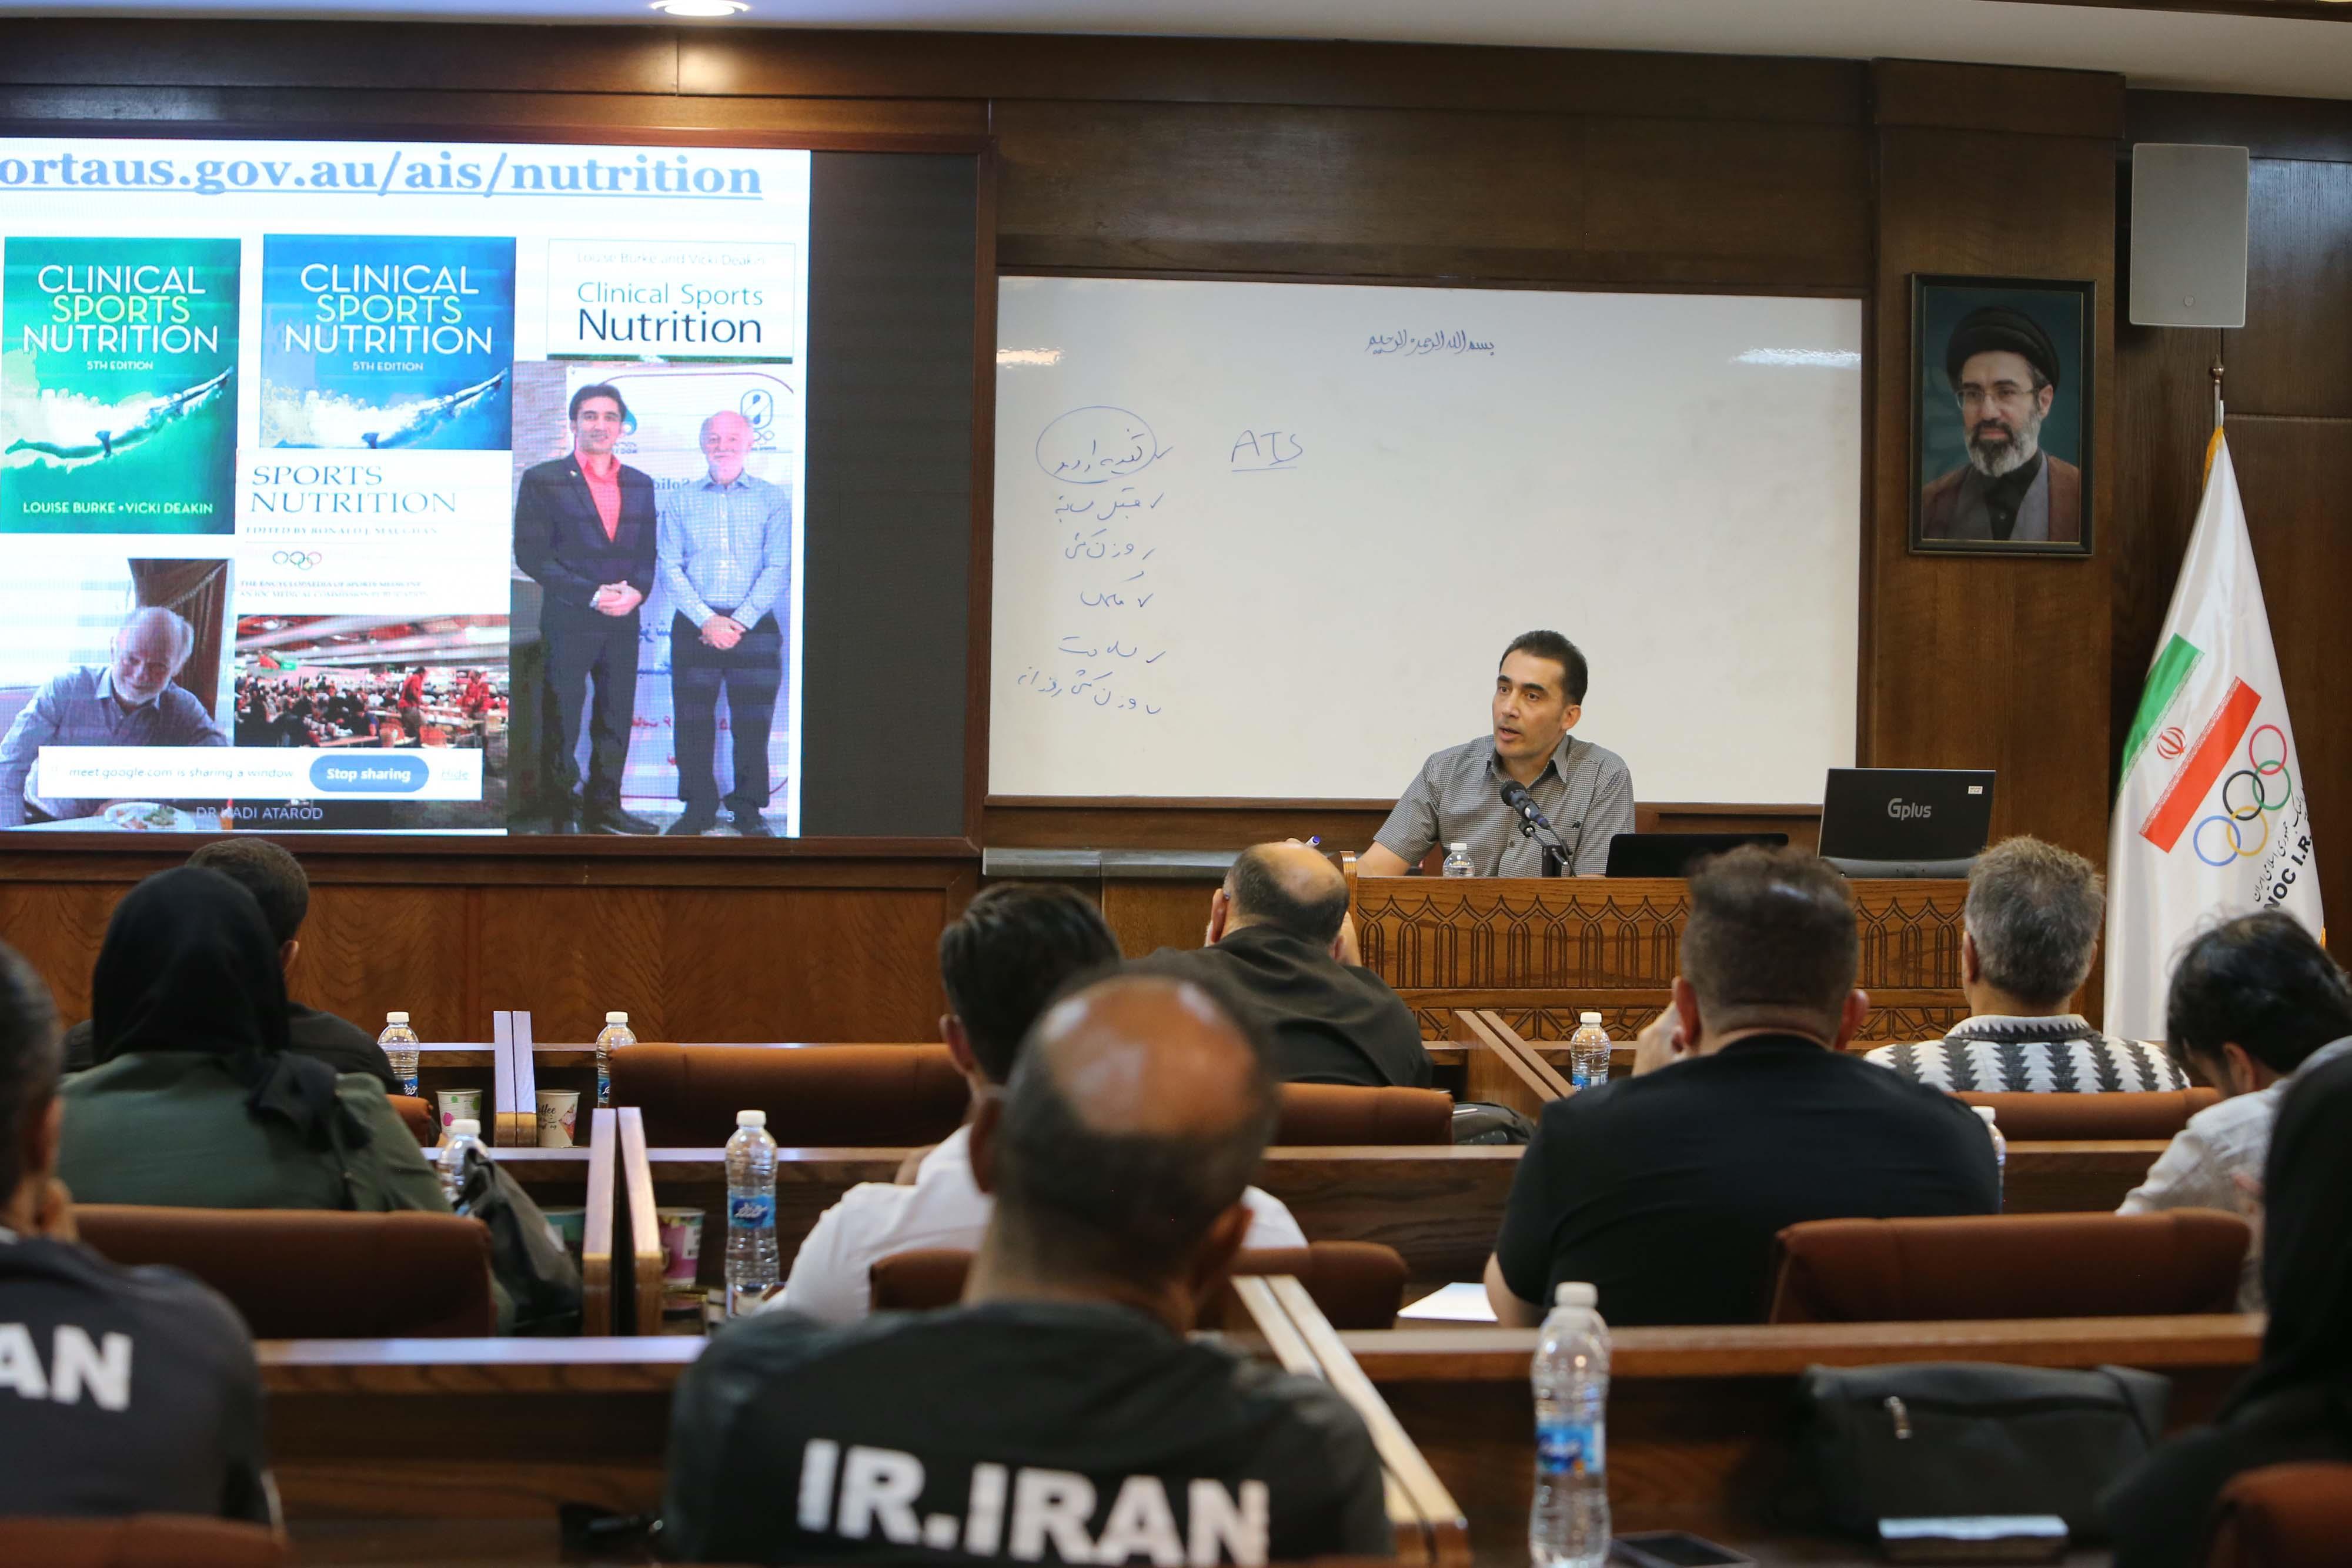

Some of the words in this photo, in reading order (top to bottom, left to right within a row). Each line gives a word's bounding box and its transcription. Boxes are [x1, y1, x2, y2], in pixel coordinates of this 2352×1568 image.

[37, 265, 206, 294] CLINICAL
[300, 263, 479, 295] CLINICAL
[578, 282, 669, 304] Clinical
[681, 283, 763, 309] Sports
[52, 295, 191, 324] SPORTS
[315, 295, 462, 324] SPORTS
[579, 308, 761, 343] Nutrition
[22, 325, 218, 354] NUTRITION
[285, 325, 493, 355] NUTRITION
[86, 361, 107, 370] 5TH
[110, 361, 153, 371] EDITION
[353, 362, 375, 371] 5TH
[377, 362, 424, 372] EDITION
[252, 465, 382, 486] SPORTS
[24, 502, 69, 514] LOUISE
[73, 502, 115, 514] BURKE
[125, 502, 161, 515] VICKI
[164, 503, 213, 515] DEAKIN
[251, 492, 456, 514] NUTRITION
[247, 768, 293, 778] window
[326, 768, 357, 782] Stop
[360, 768, 411, 783] sharing
[442, 769, 469, 780] Hide
[196, 807, 216, 819] DR
[262, 807, 323, 820] ATAROD
[1887, 797, 1932, 821] Gplus
[2264, 868, 2296, 909] NOC
[796, 1437, 1271, 1567] IR.IRAN
